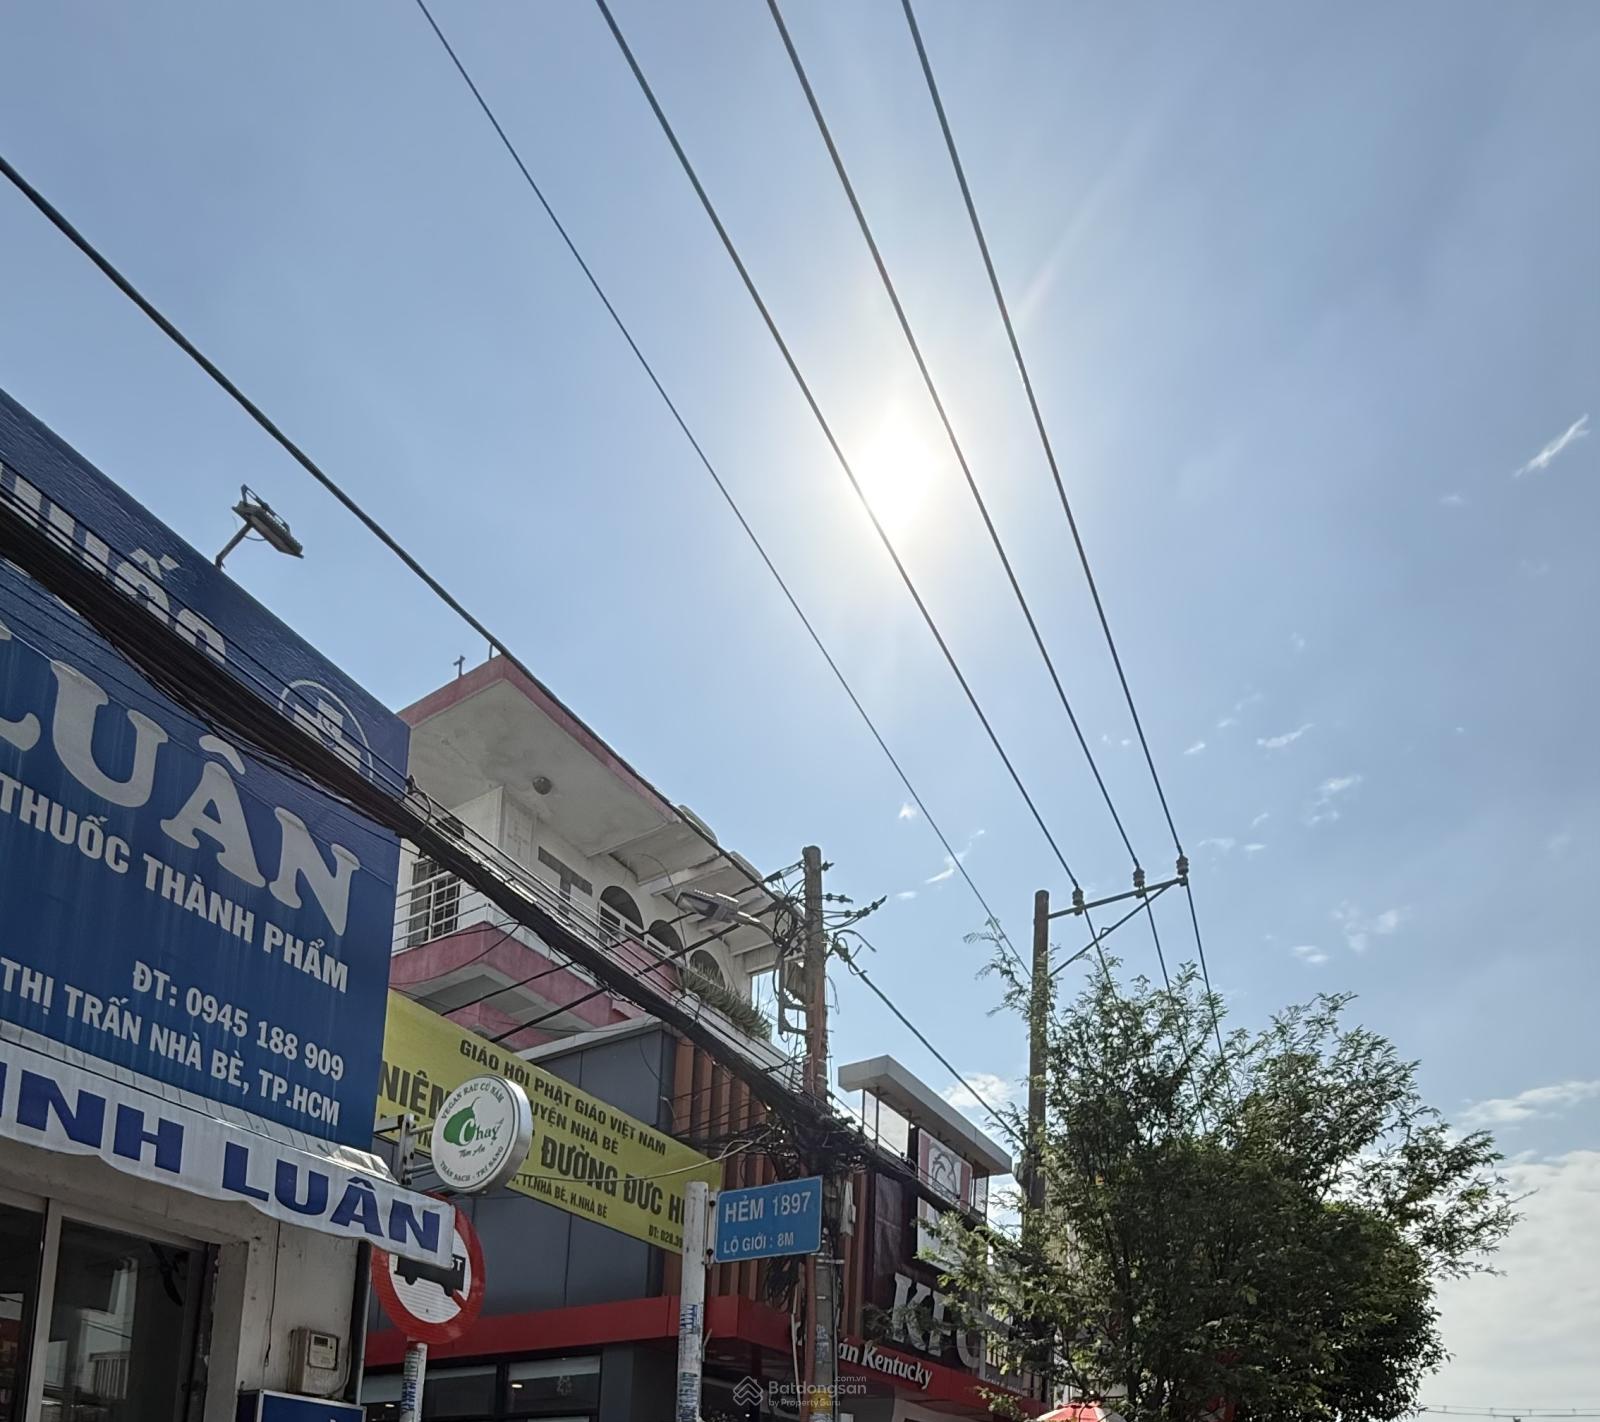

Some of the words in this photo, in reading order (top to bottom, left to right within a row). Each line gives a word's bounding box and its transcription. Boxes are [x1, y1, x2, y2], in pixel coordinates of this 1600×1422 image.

[143, 853, 255, 944] THÀNH
[263, 921, 348, 994] PHẨM
[0, 956, 55, 1015] THỊ
[64, 983, 142, 1046] TRẤN
[149, 1026, 202, 1072] NHÀ
[259, 1068, 340, 1127] TP.HCM
[132, 960, 177, 1008] ĐT:
[186, 987, 249, 1039] 0945
[257, 1020, 298, 1062] 188
[304, 1041, 344, 1082] 909
[441, 1091, 463, 1120] VEGAN
[460, 1039, 500, 1071] GIÁO
[534, 1078, 572, 1108] PHẬT
[575, 1099, 607, 1125] GIÁO
[610, 1115, 636, 1140] VIỆT
[639, 1130, 667, 1156] NAM
[530, 1100, 567, 1130] UYỆN
[571, 1121, 598, 1146] NHÀ
[0, 1060, 185, 1174] NH
[222, 1141, 440, 1254] LUÂN
[541, 1134, 618, 1197] ĐƯỜNG
[724, 1193, 764, 1224] HẺM
[772, 1191, 812, 1217] 1897
[723, 1239, 739, 1256] LỘ
[742, 1231, 767, 1250] GIỚI
[777, 1231, 794, 1248] 8M
[861, 1339, 933, 1390] Kentucky
